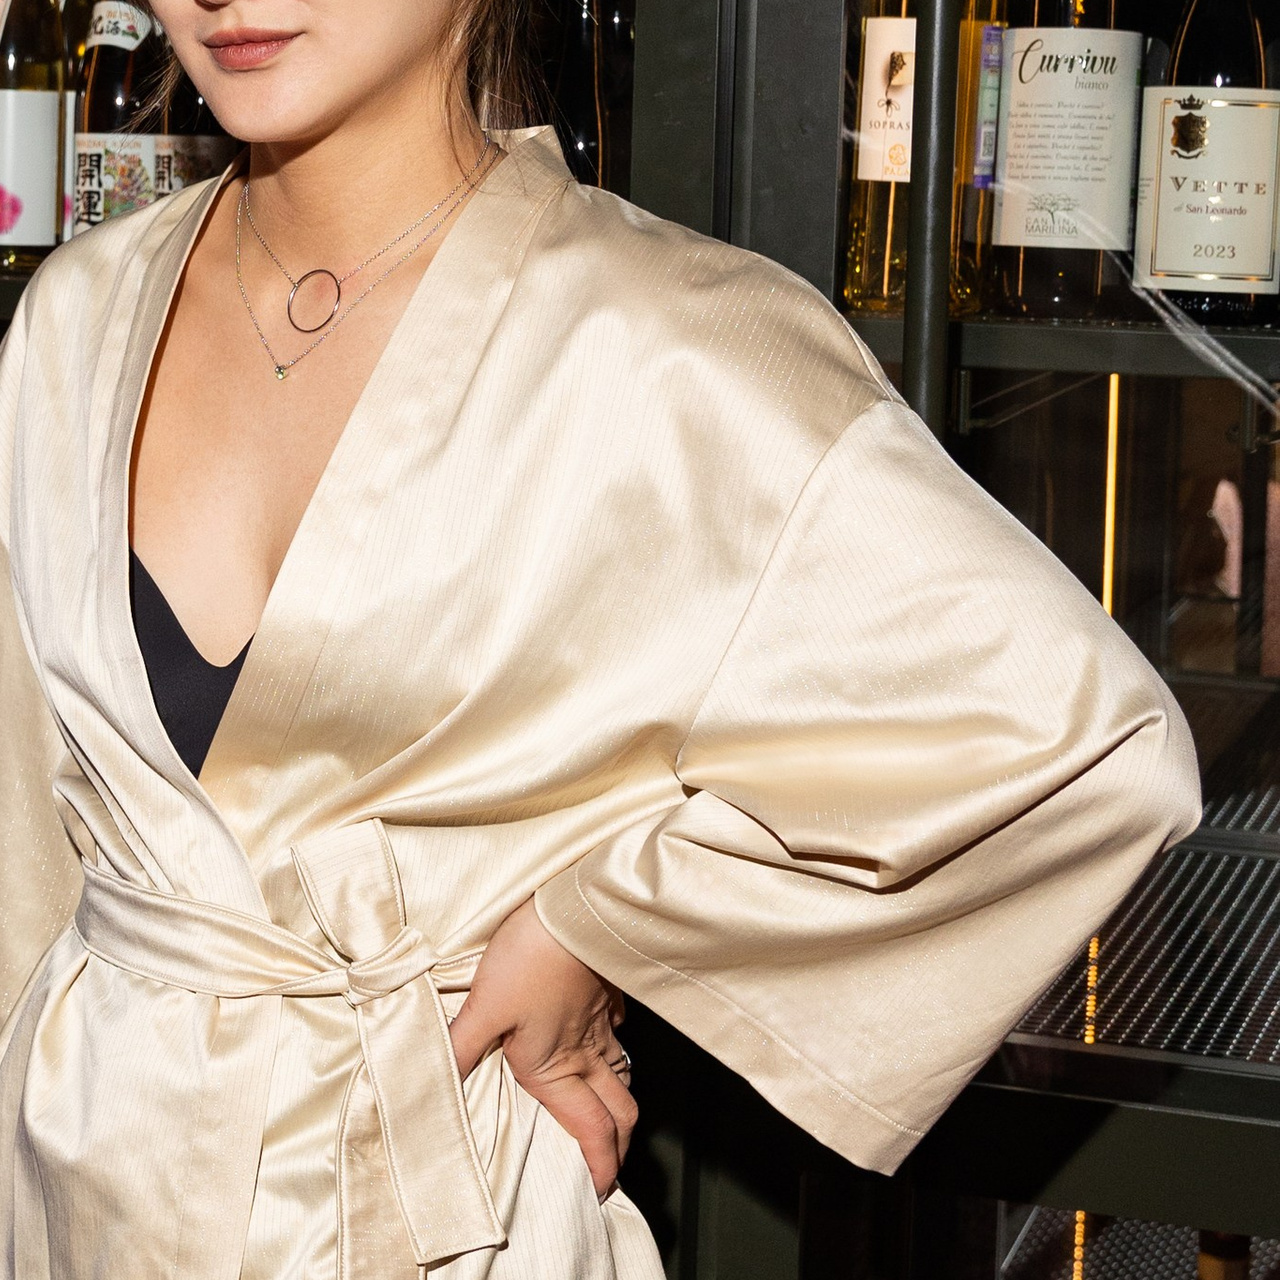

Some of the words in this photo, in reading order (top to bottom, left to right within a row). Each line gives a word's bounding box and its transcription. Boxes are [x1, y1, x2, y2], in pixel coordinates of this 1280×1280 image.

[1013, 38, 1118, 85] Currivu
[1074, 76, 1109, 91] bianco
[155, 154, 174, 196] 開
[1169, 176, 1267, 196] VETTE
[1185, 205, 1203, 214] San
[1205, 204, 1247, 216] Leonardo
[1024, 223, 1079, 236] MARILINA
[1192, 243, 1237, 259] 2023
